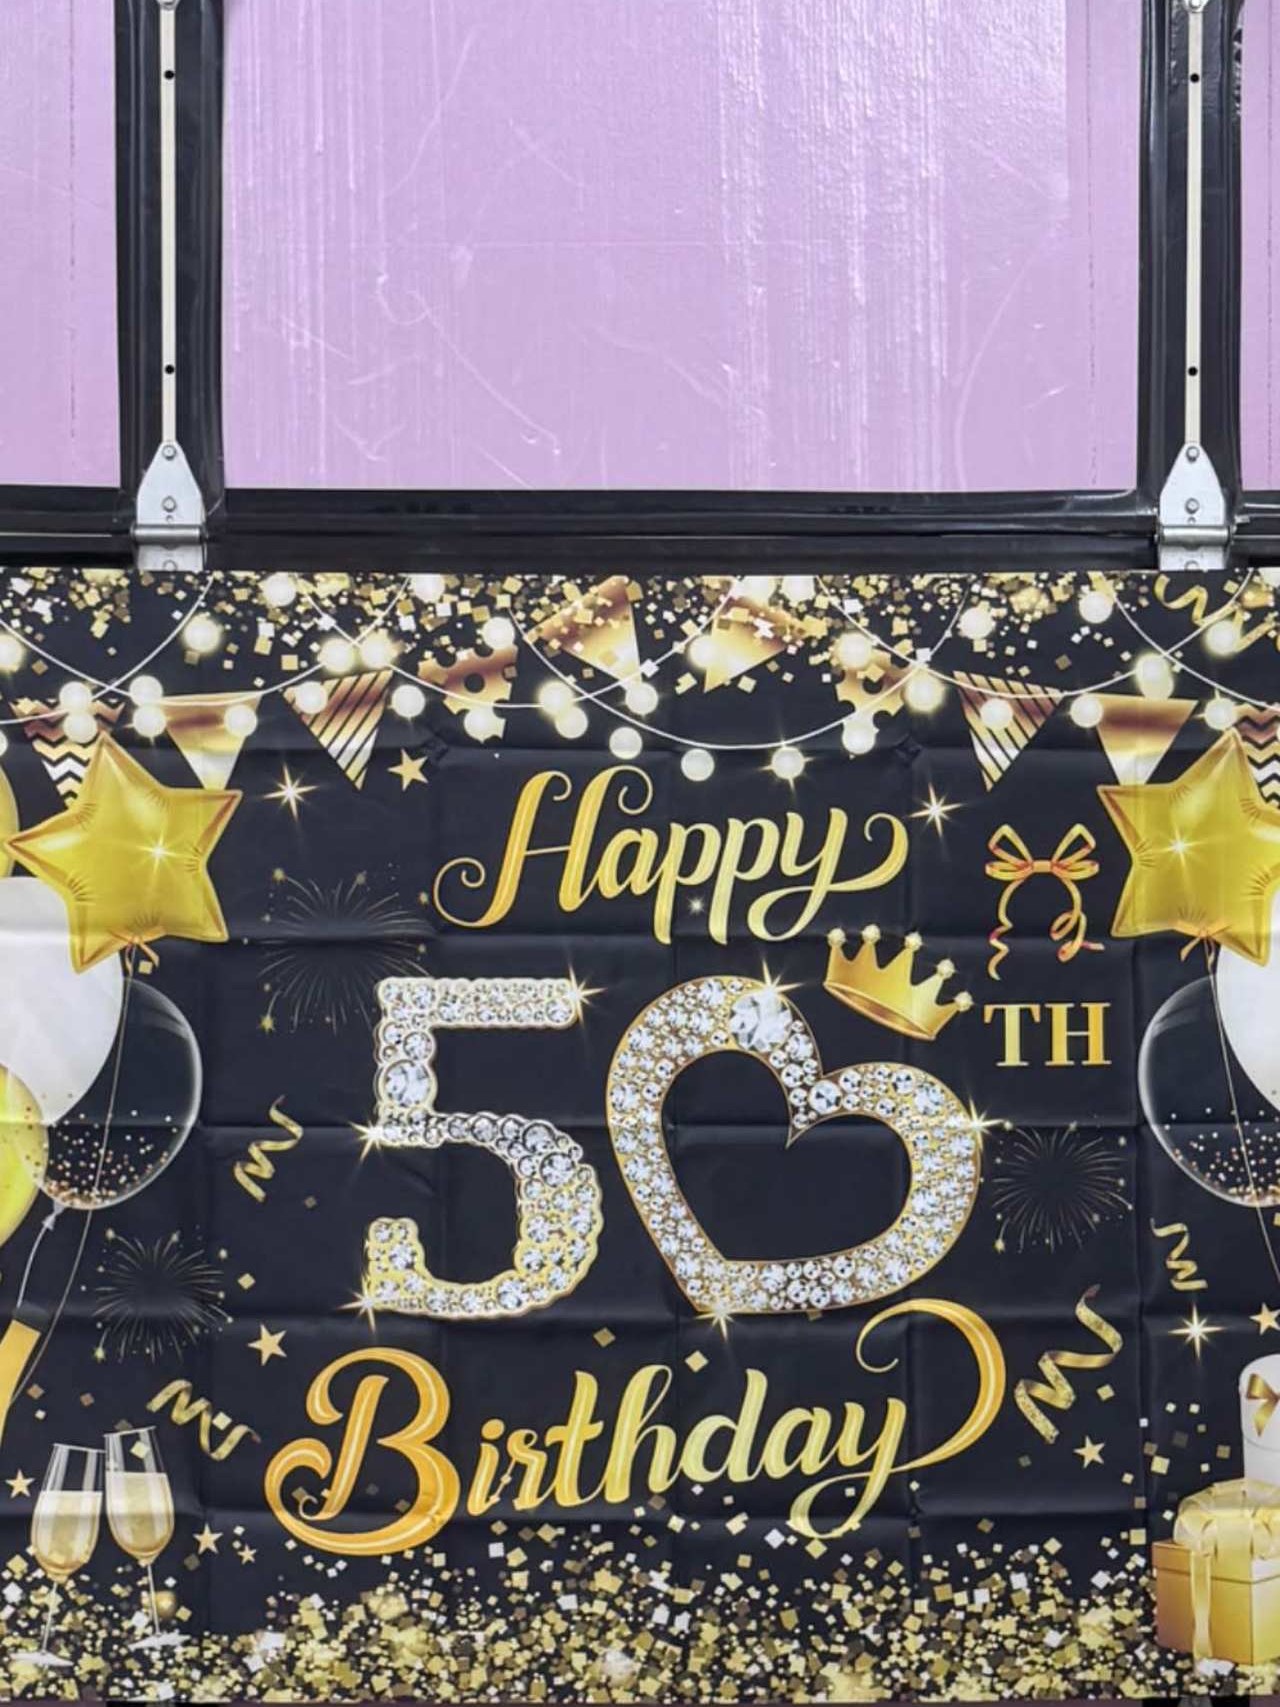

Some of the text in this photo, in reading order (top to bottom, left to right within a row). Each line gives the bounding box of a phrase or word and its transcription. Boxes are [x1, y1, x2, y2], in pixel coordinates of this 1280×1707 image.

[433, 765, 909, 945] Happy
[983, 1002, 1111, 1067] TH
[264, 1298, 1007, 1556] Birthday
